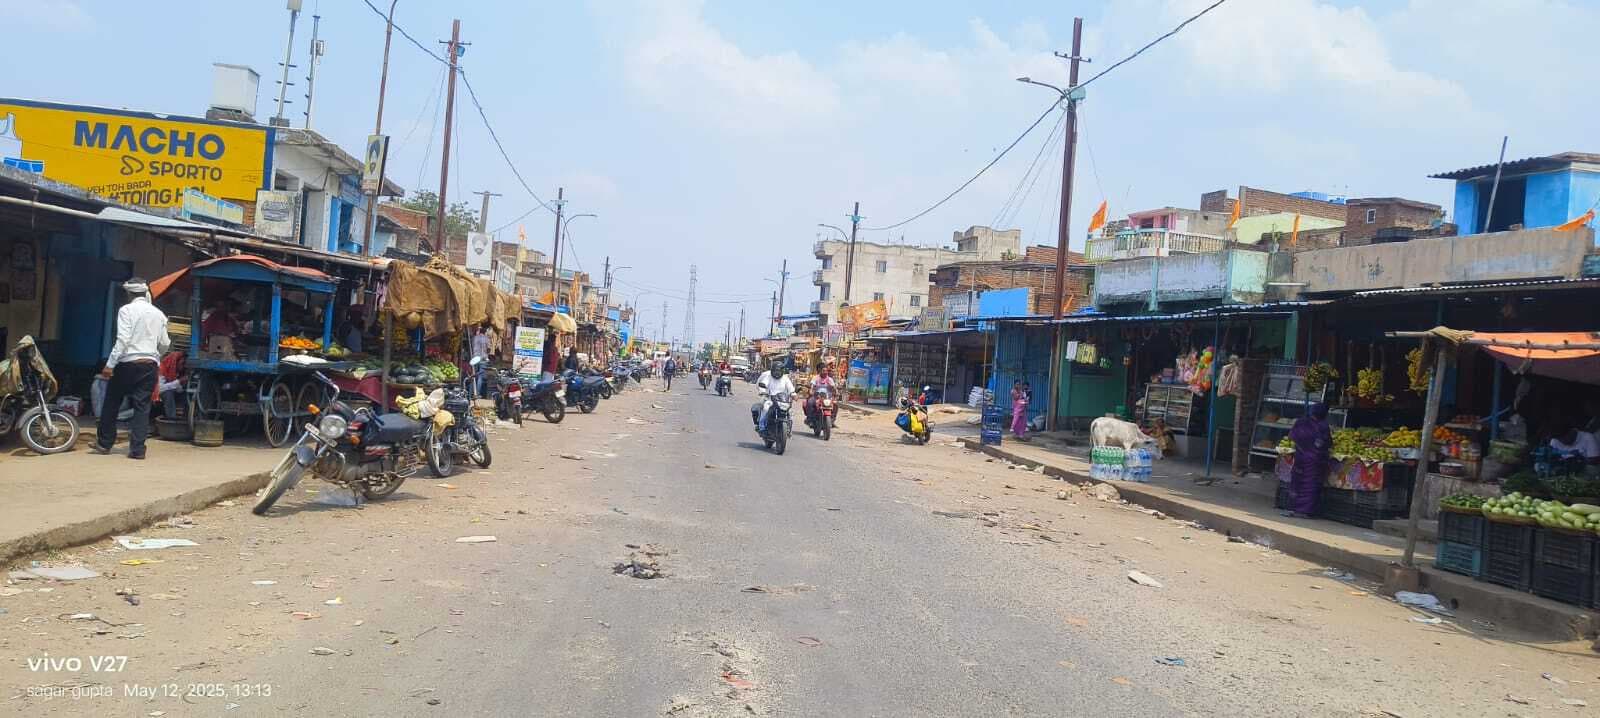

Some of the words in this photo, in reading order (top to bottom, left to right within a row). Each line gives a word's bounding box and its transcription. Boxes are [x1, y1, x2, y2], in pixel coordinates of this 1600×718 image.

[74, 120, 225, 160] MACHO
[149, 160, 222, 181] SPORTO
[107, 183, 125, 192] TOH
[127, 180, 152, 190] BADA
